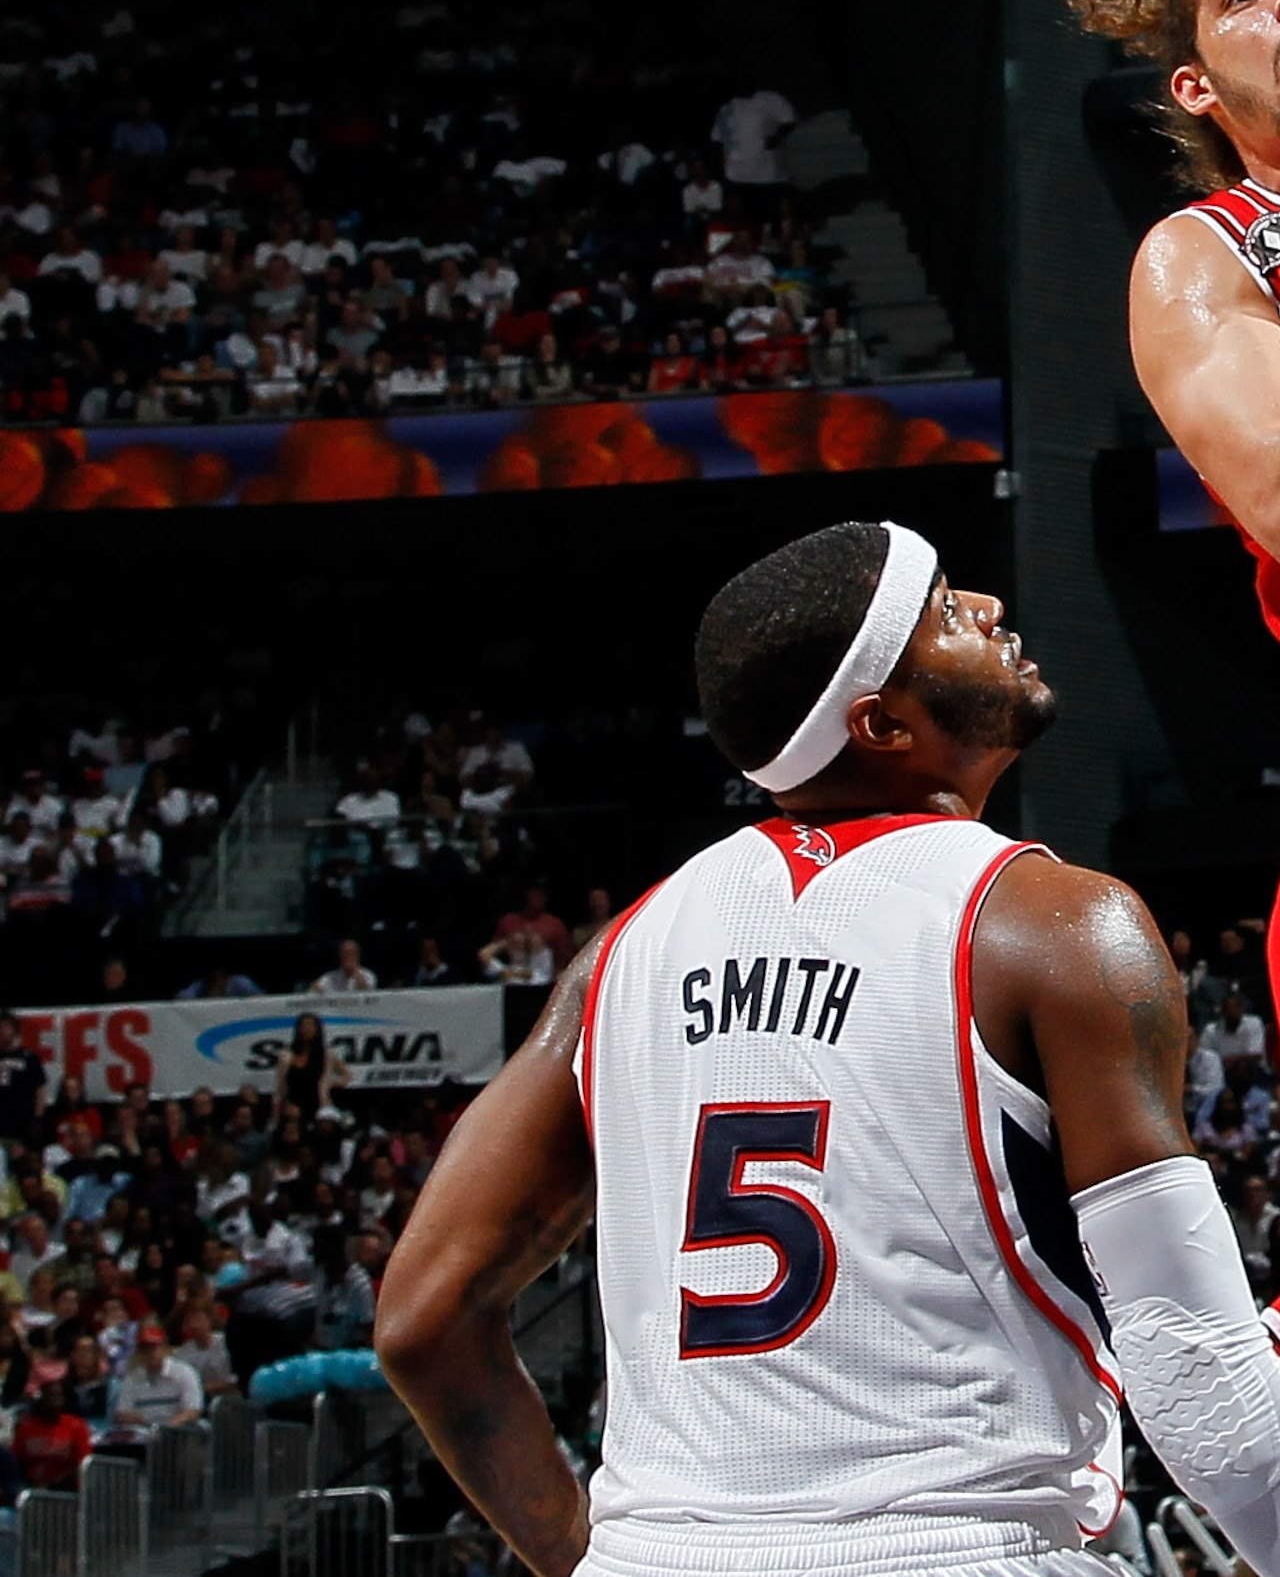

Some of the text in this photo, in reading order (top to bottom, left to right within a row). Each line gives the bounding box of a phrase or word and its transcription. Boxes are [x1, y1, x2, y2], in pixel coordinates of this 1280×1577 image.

[682, 957, 861, 1046] SMITH
[246, 1033, 442, 1070] SANA
[679, 1100, 838, 1360] 5
